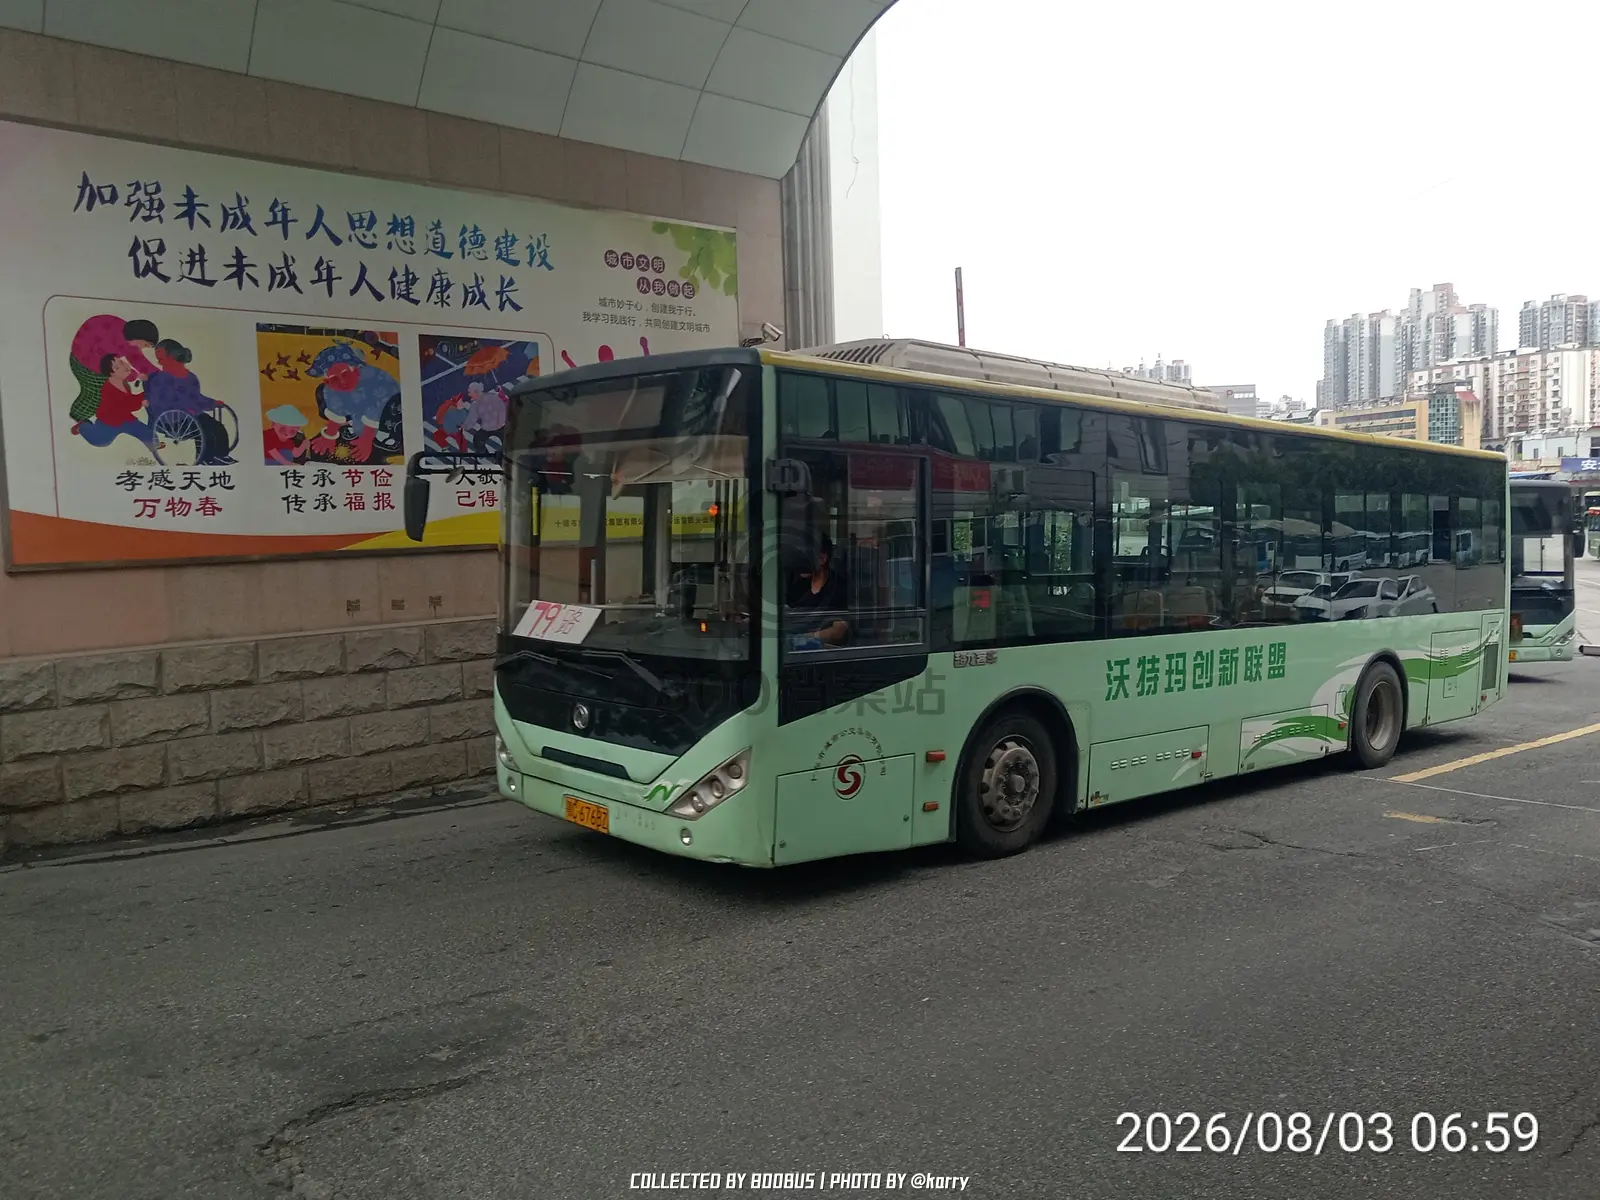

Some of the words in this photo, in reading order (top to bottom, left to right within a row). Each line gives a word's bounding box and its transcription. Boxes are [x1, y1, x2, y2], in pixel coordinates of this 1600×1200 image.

[73, 170, 555, 271] 加强未成年人思想道德建设
[604, 250, 666, 273] 城市文明
[128, 235, 524, 313] 促进未成年人健康成长
[637, 276, 695, 299] 从我做起
[1581, 459, 1600, 470] 安
[115, 468, 236, 492] 孝感天地
[280, 468, 394, 489] 传承节俭
[455, 467, 502, 486] 人敬
[133, 495, 223, 519] 万物春
[281, 492, 396, 514] 传承福报
[1105, 642, 1287, 701] 沃特玛创新联盟
